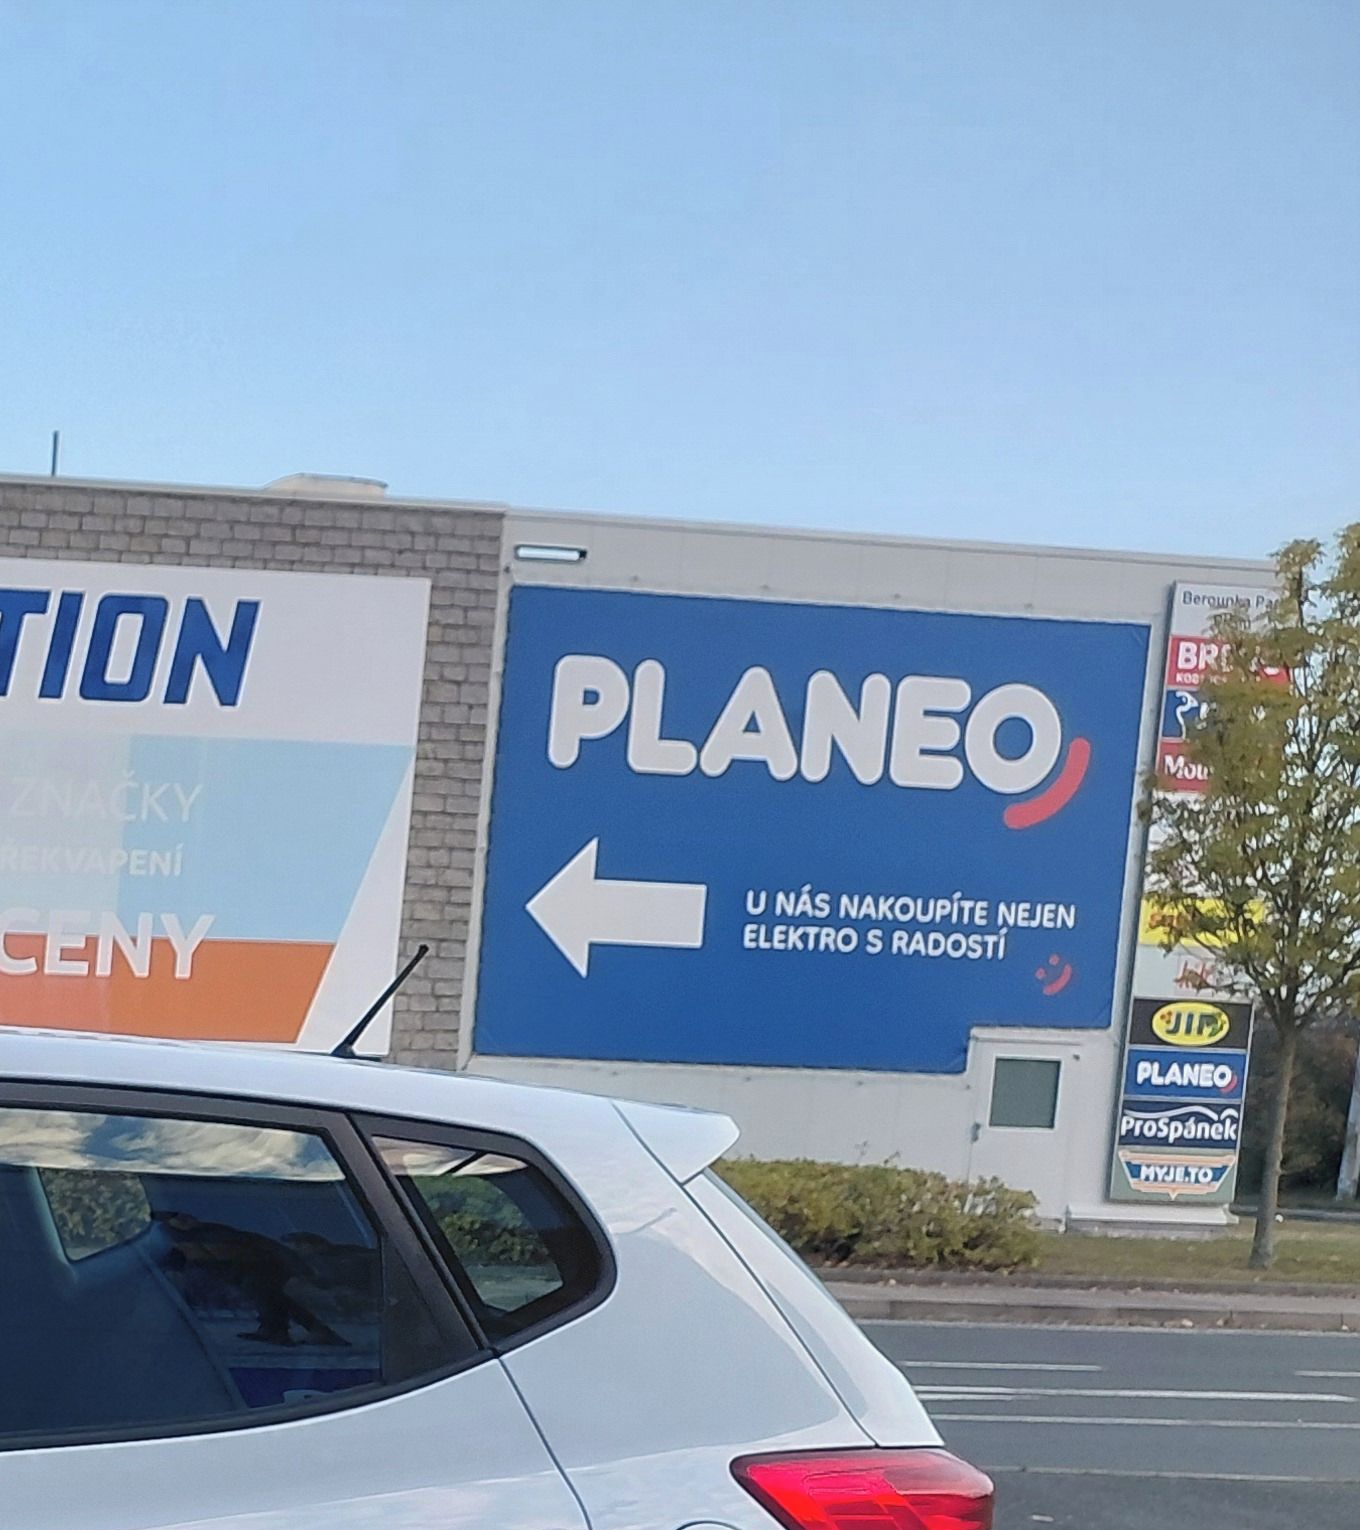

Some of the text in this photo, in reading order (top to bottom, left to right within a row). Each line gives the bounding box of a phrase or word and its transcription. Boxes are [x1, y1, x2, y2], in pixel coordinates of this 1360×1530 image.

[546, 653, 1063, 795] PLANEO
[11, 769, 203, 824] ZNAČKY
[745, 883, 1077, 930] U NÁS NAKOUPÍTE NEJEN
[742, 923, 1010, 961] ELEKTRO S RADOSTÍ
[1136, 1060, 1233, 1088] PLANEO
[1120, 1115, 1238, 1144] ProSpánek
